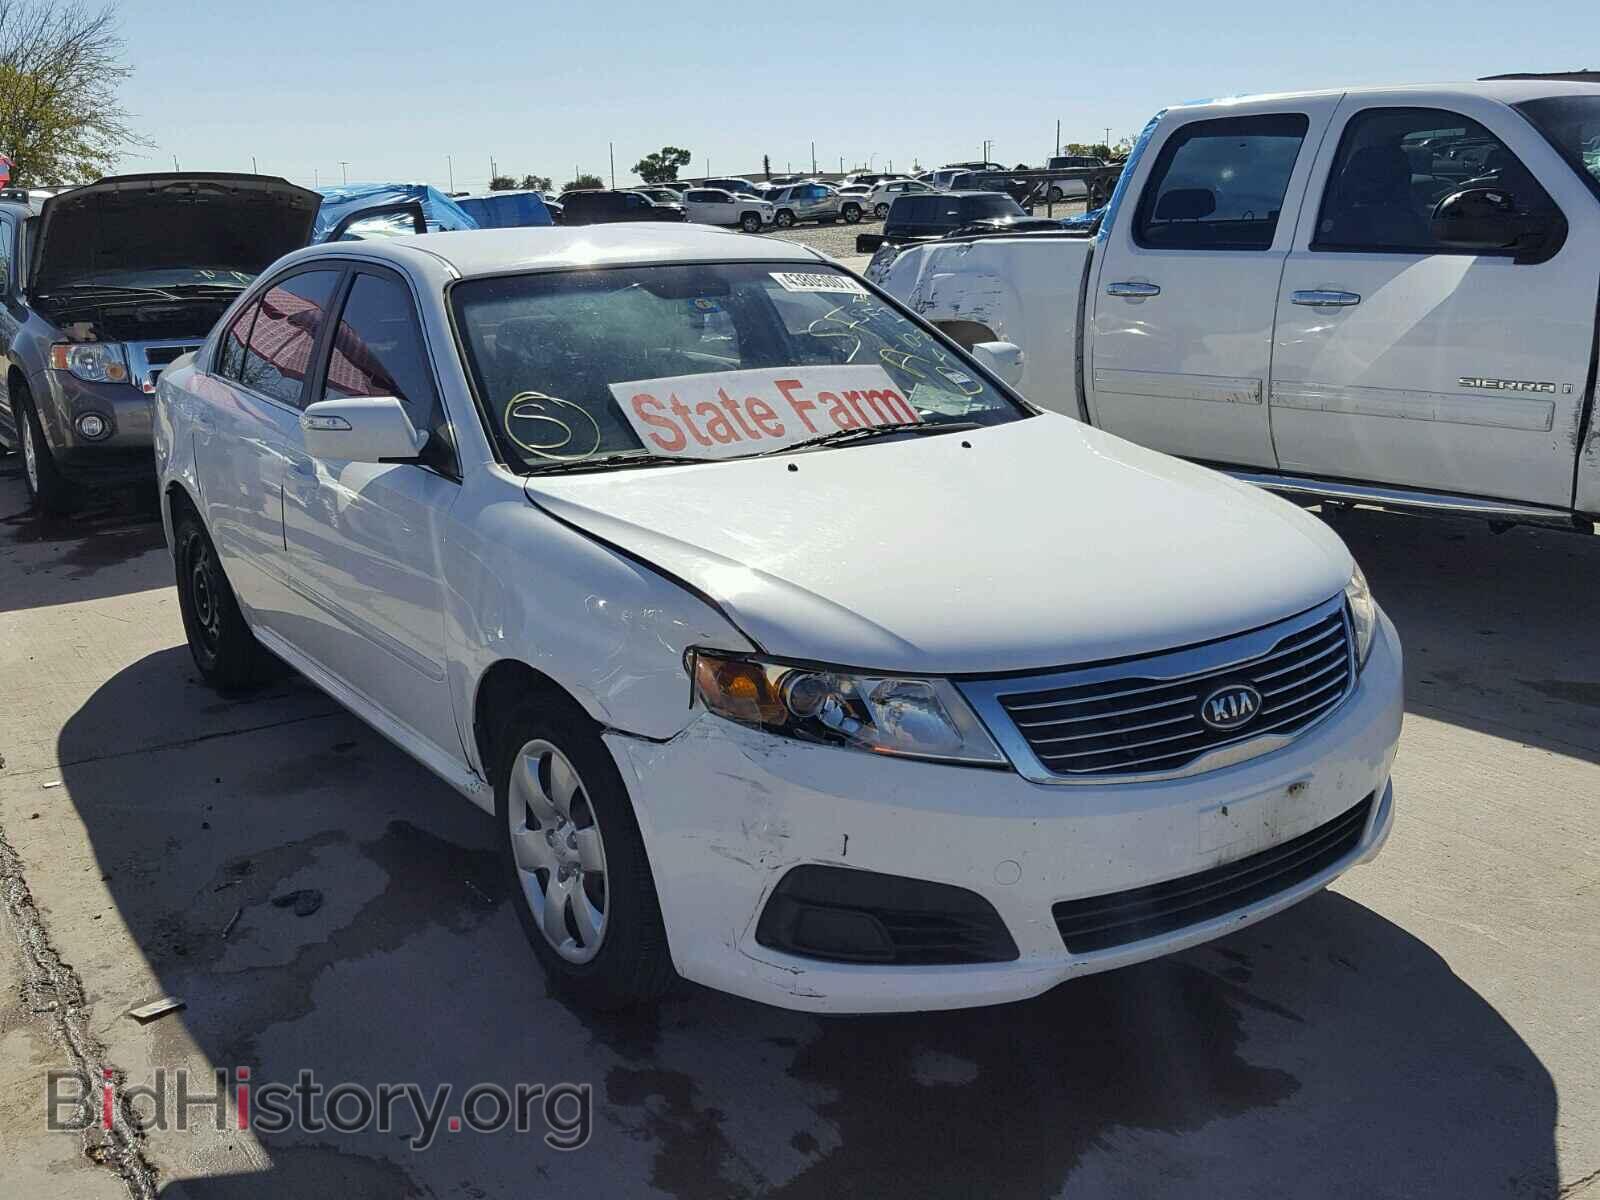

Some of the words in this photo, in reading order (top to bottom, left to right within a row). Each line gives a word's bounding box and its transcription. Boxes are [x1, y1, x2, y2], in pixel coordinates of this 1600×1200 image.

[1457, 376, 1556, 394] SIERRA
[631, 386, 785, 452] State
[774, 379, 918, 433] Farm
[1210, 692, 1253, 721] KIA
